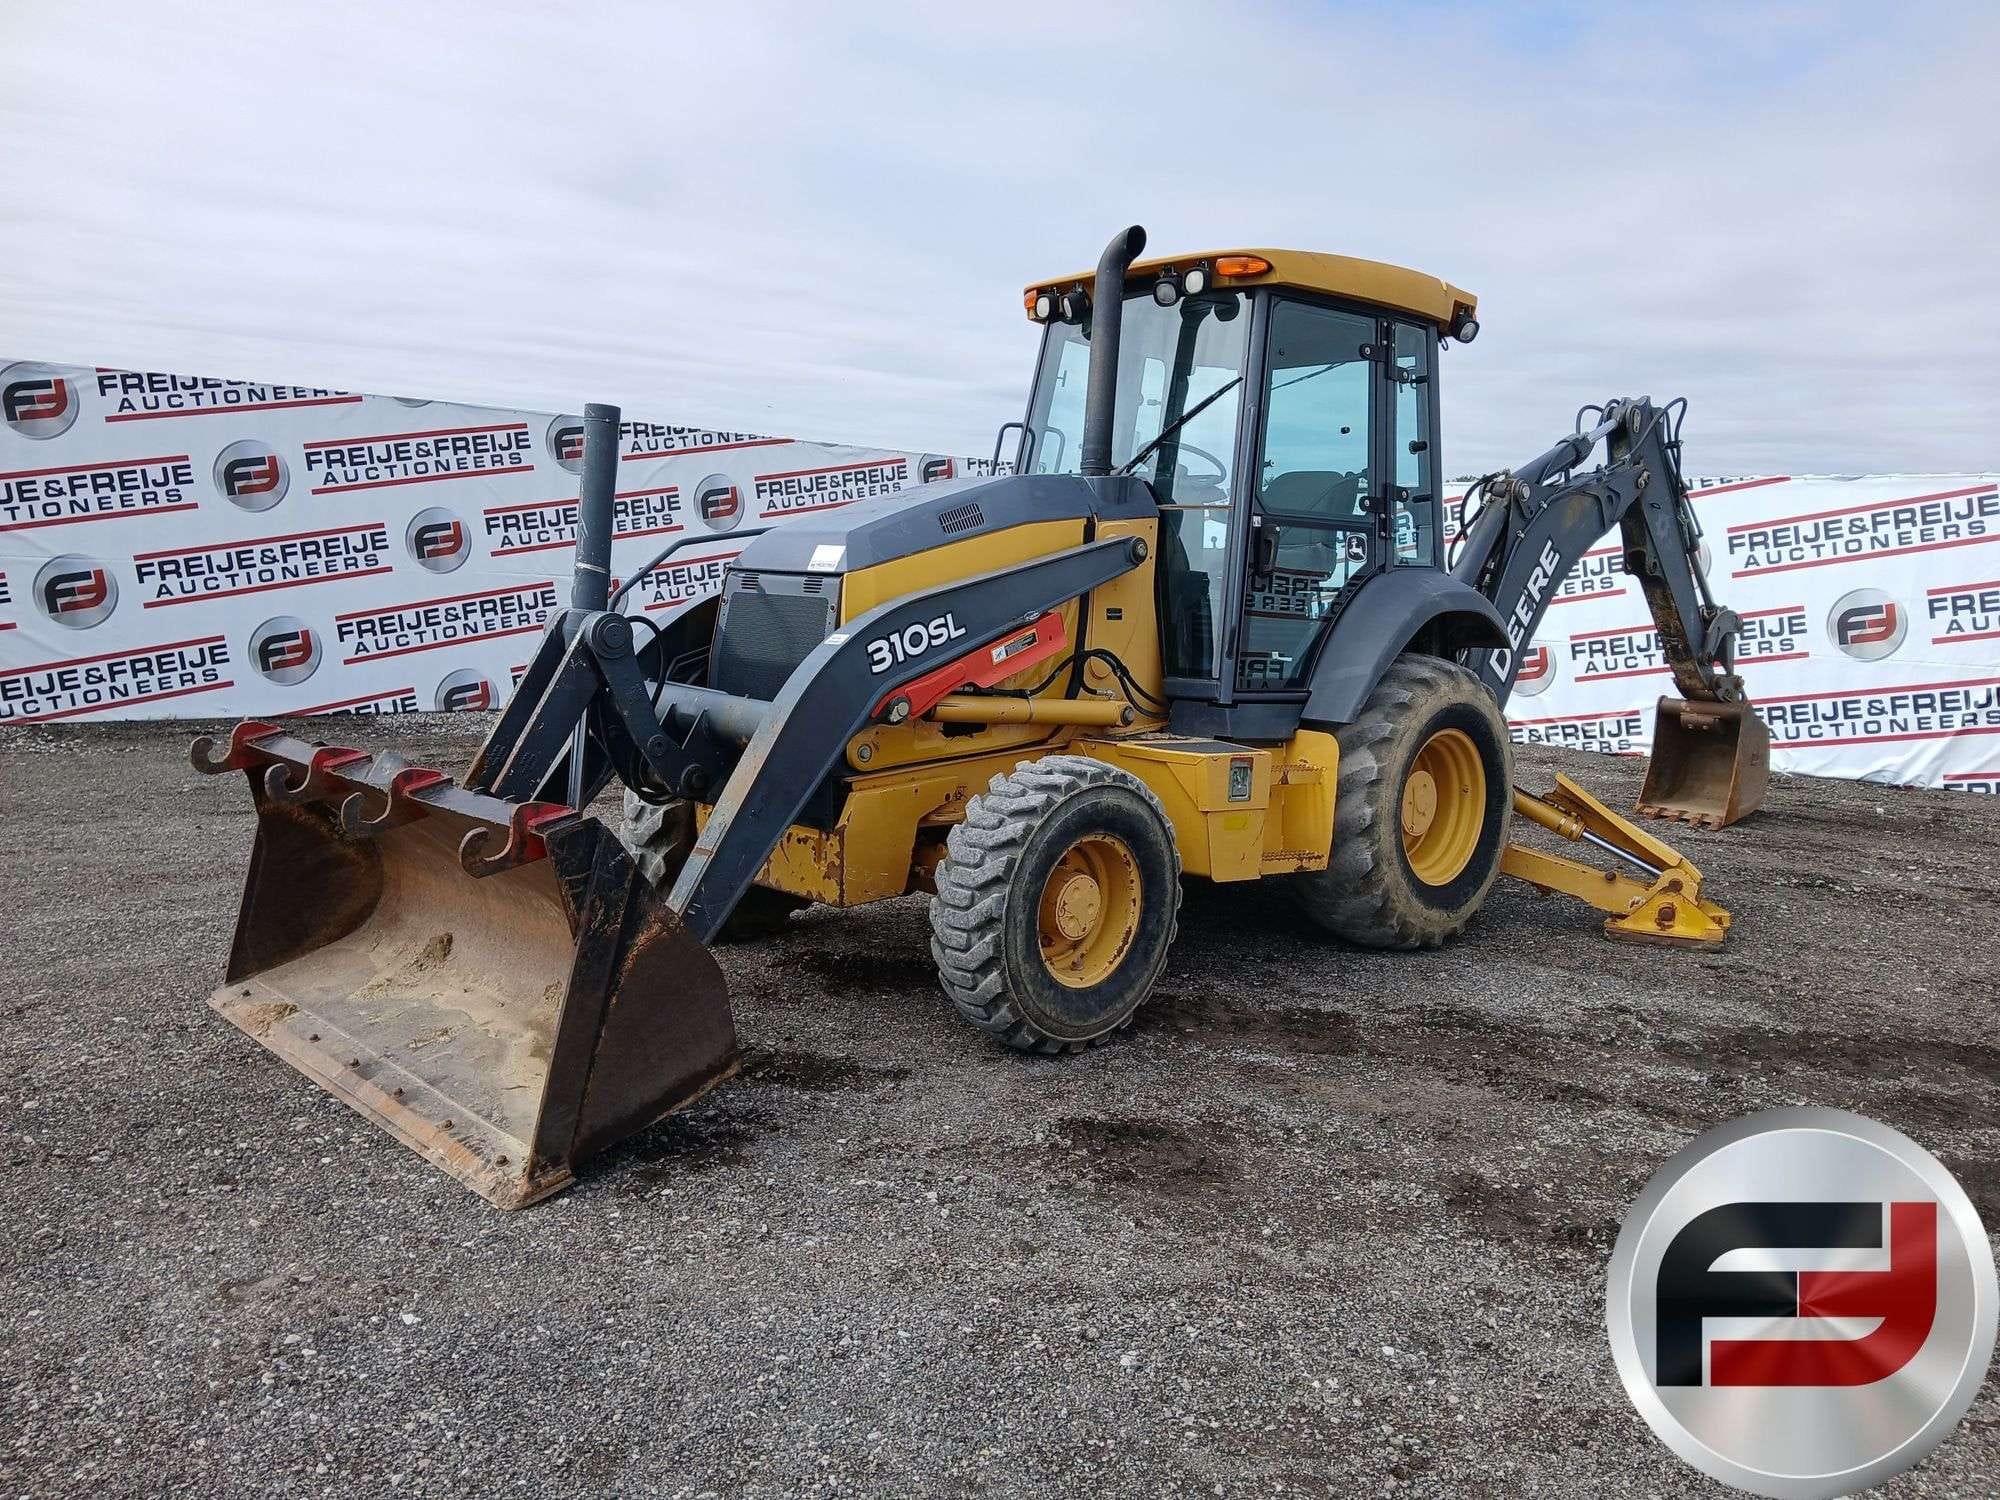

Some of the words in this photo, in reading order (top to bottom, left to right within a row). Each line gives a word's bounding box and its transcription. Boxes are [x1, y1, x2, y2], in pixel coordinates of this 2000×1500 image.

[117, 385, 348, 413] AUCTIONEER
[304, 431, 532, 472] FREIJE&FREIJE
[322, 451, 523, 486] AUCTIONEERS
[755, 464, 909, 499] FREIJE&FREIJE
[766, 481, 902, 511] AUCTIONEERS
[3, 488, 183, 521] TIONEERS
[1727, 494, 2000, 555] FREIJE&FREIJE
[135, 530, 390, 585] FREIJE&FREIJE
[1744, 519, 1987, 569] AUCTIONEERS
[156, 553, 380, 599] AUCTIONEERS
[653, 580, 725, 602] AUCTI
[336, 589, 558, 643] FREIJE&FREIJE
[354, 609, 548, 656] AUCTIONEERS
[1489, 539, 1561, 683] DEERE
[866, 612, 967, 675] 310SL
[1754, 686, 2000, 726] REIJE&FREIJ
